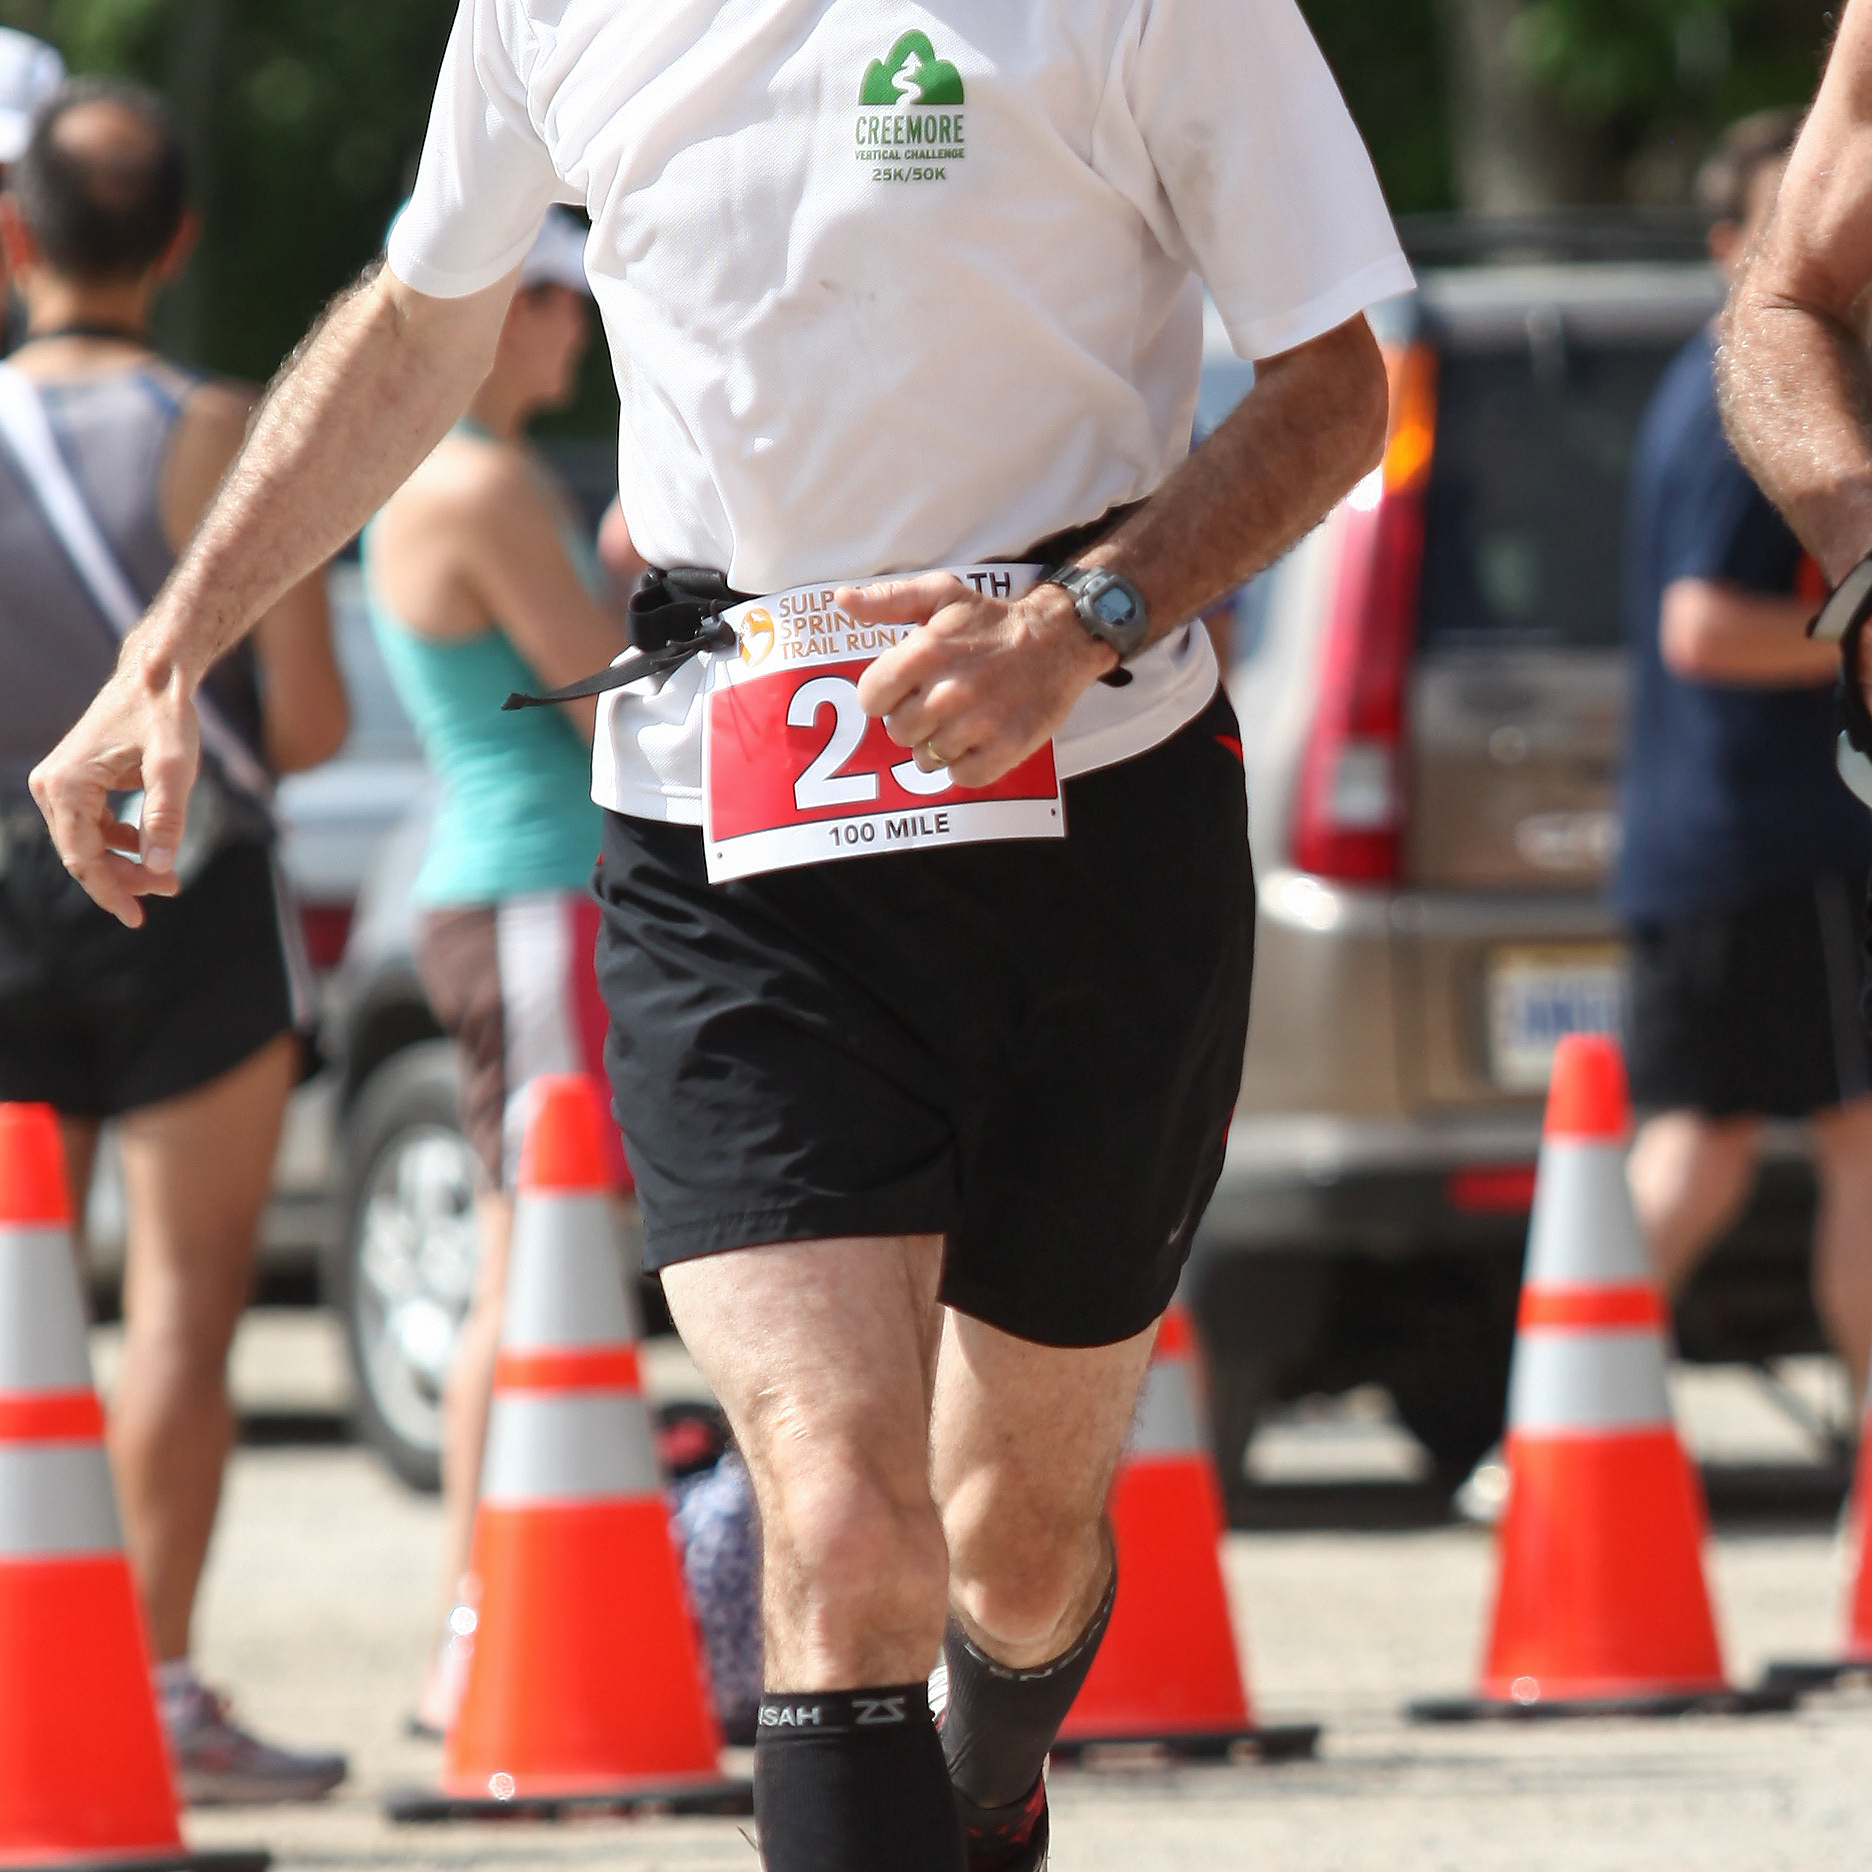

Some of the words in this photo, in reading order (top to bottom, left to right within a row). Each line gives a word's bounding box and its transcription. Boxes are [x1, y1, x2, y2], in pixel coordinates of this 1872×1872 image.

[855, 114, 964, 144] CREEMORE
[855, 150, 901, 160] VERTICAL
[904, 148, 964, 160] CHALLENGE
[872, 167, 947, 183] 25K/50K
[780, 609, 872, 640] SPRIN
[781, 641, 840, 661] TRAIL
[846, 628, 896, 652] RUN
[829, 820, 876, 848] 100
[885, 811, 951, 841] MILE
